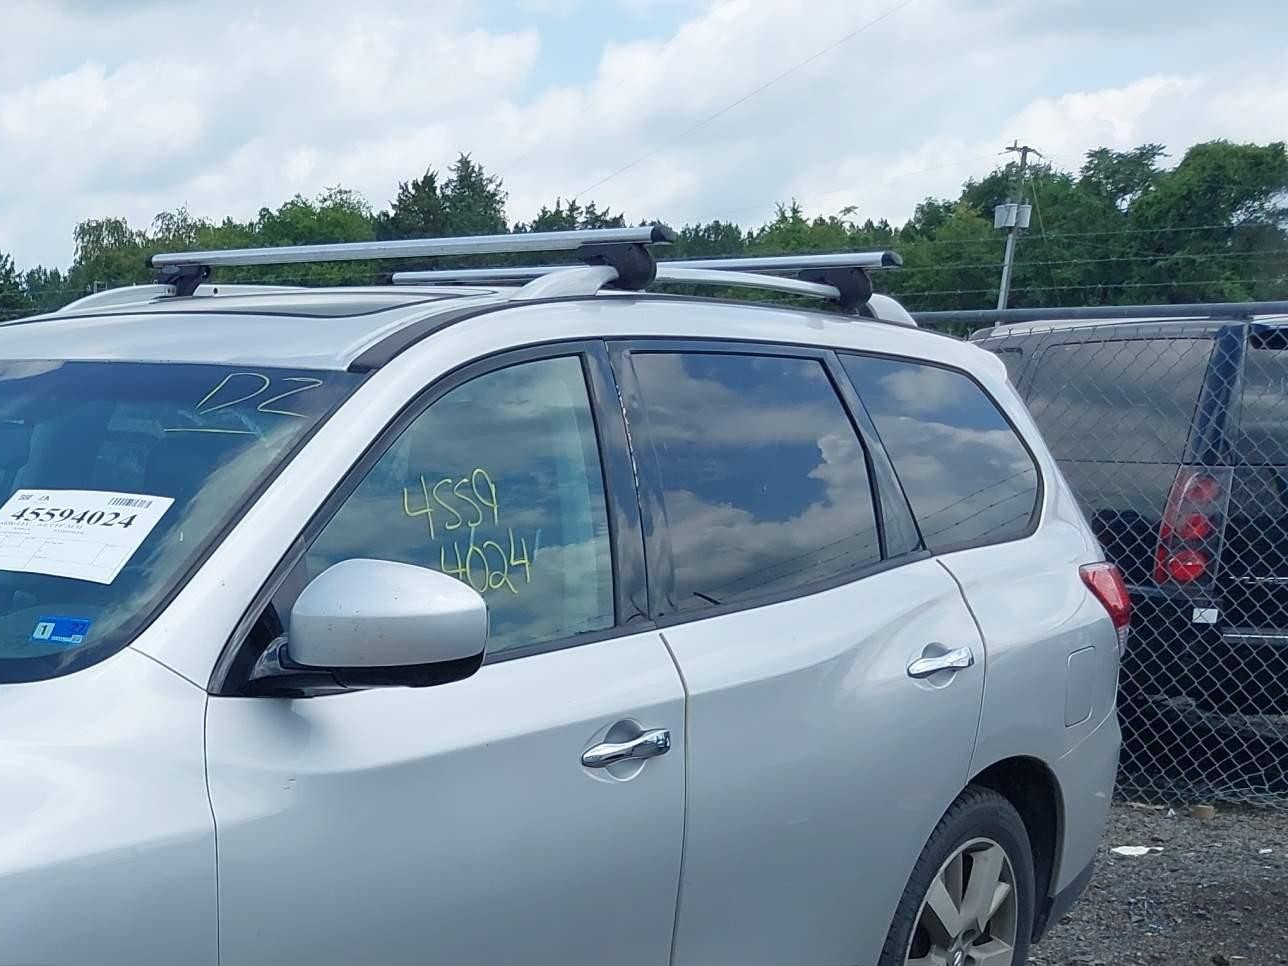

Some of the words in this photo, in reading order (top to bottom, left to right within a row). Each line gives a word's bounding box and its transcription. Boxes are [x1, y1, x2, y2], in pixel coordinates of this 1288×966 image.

[10, 507, 139, 530] 45594024
[402, 468, 499, 540] 4559
[441, 528, 534, 594] 4024
